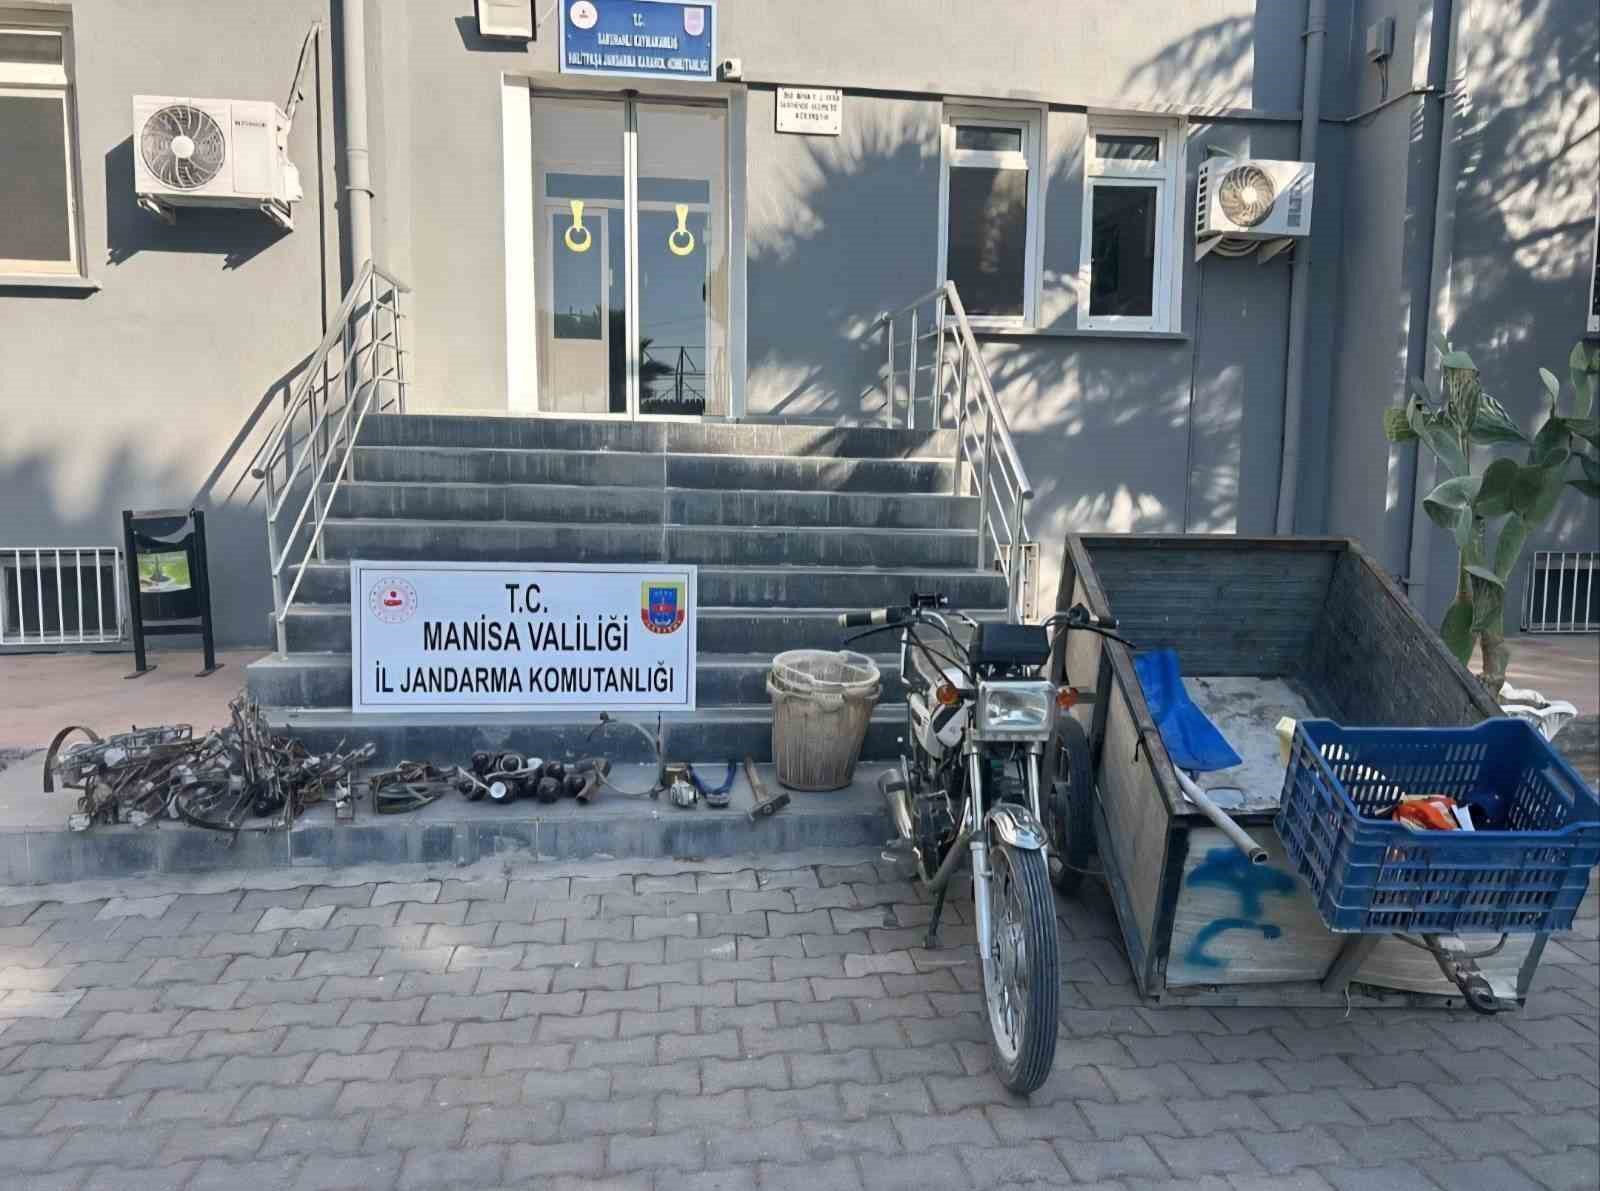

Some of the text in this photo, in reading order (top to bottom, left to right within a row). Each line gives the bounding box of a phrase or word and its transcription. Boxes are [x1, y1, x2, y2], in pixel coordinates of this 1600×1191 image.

[506, 584, 547, 613] T.C.
[424, 614, 628, 651] MANİSA VALİLİĞİ
[376, 661, 674, 692] İL JANDARMA KOMUTANLIĞI
